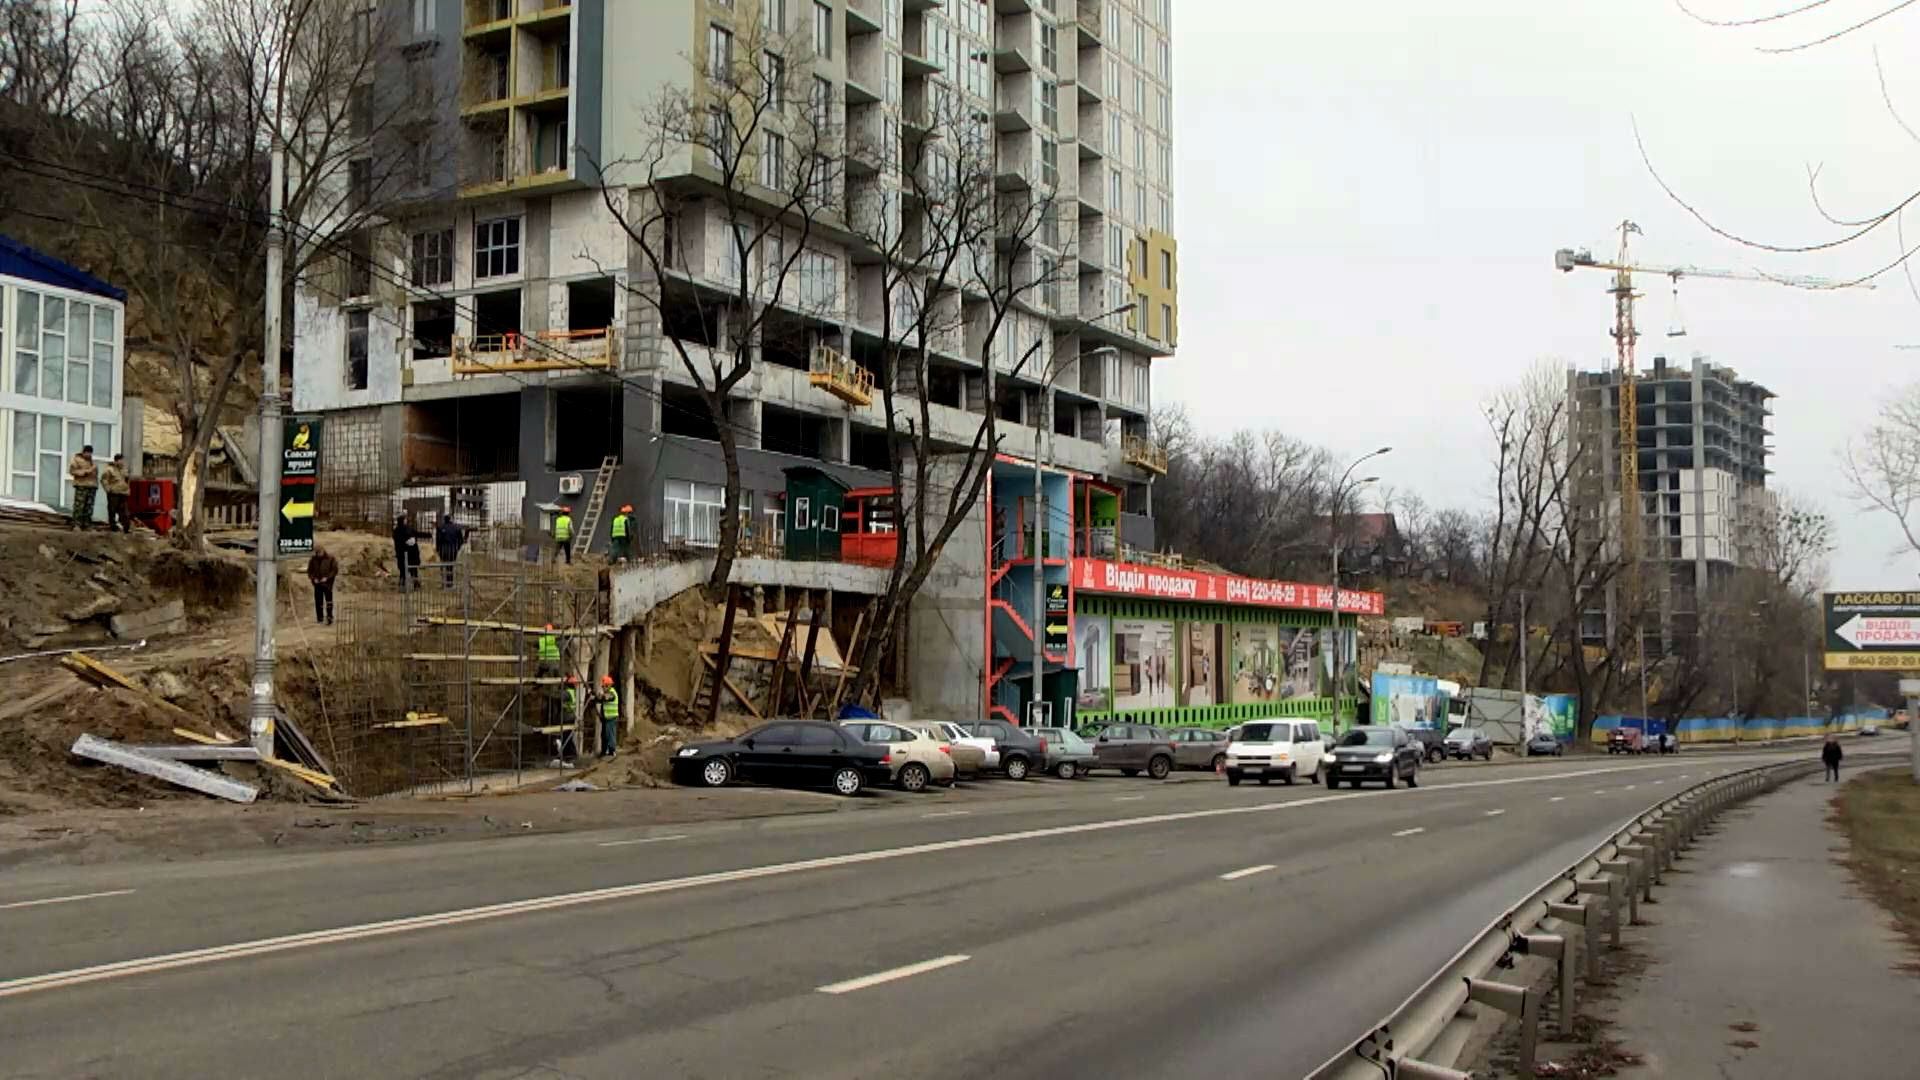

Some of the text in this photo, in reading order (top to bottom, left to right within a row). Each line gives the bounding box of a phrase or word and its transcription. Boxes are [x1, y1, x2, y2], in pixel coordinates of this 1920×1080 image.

[1105, 563, 1145, 592] Відділ
[1147, 575, 1197, 598] продажу
[1833, 593, 1903, 605] ЛАСКАВО
